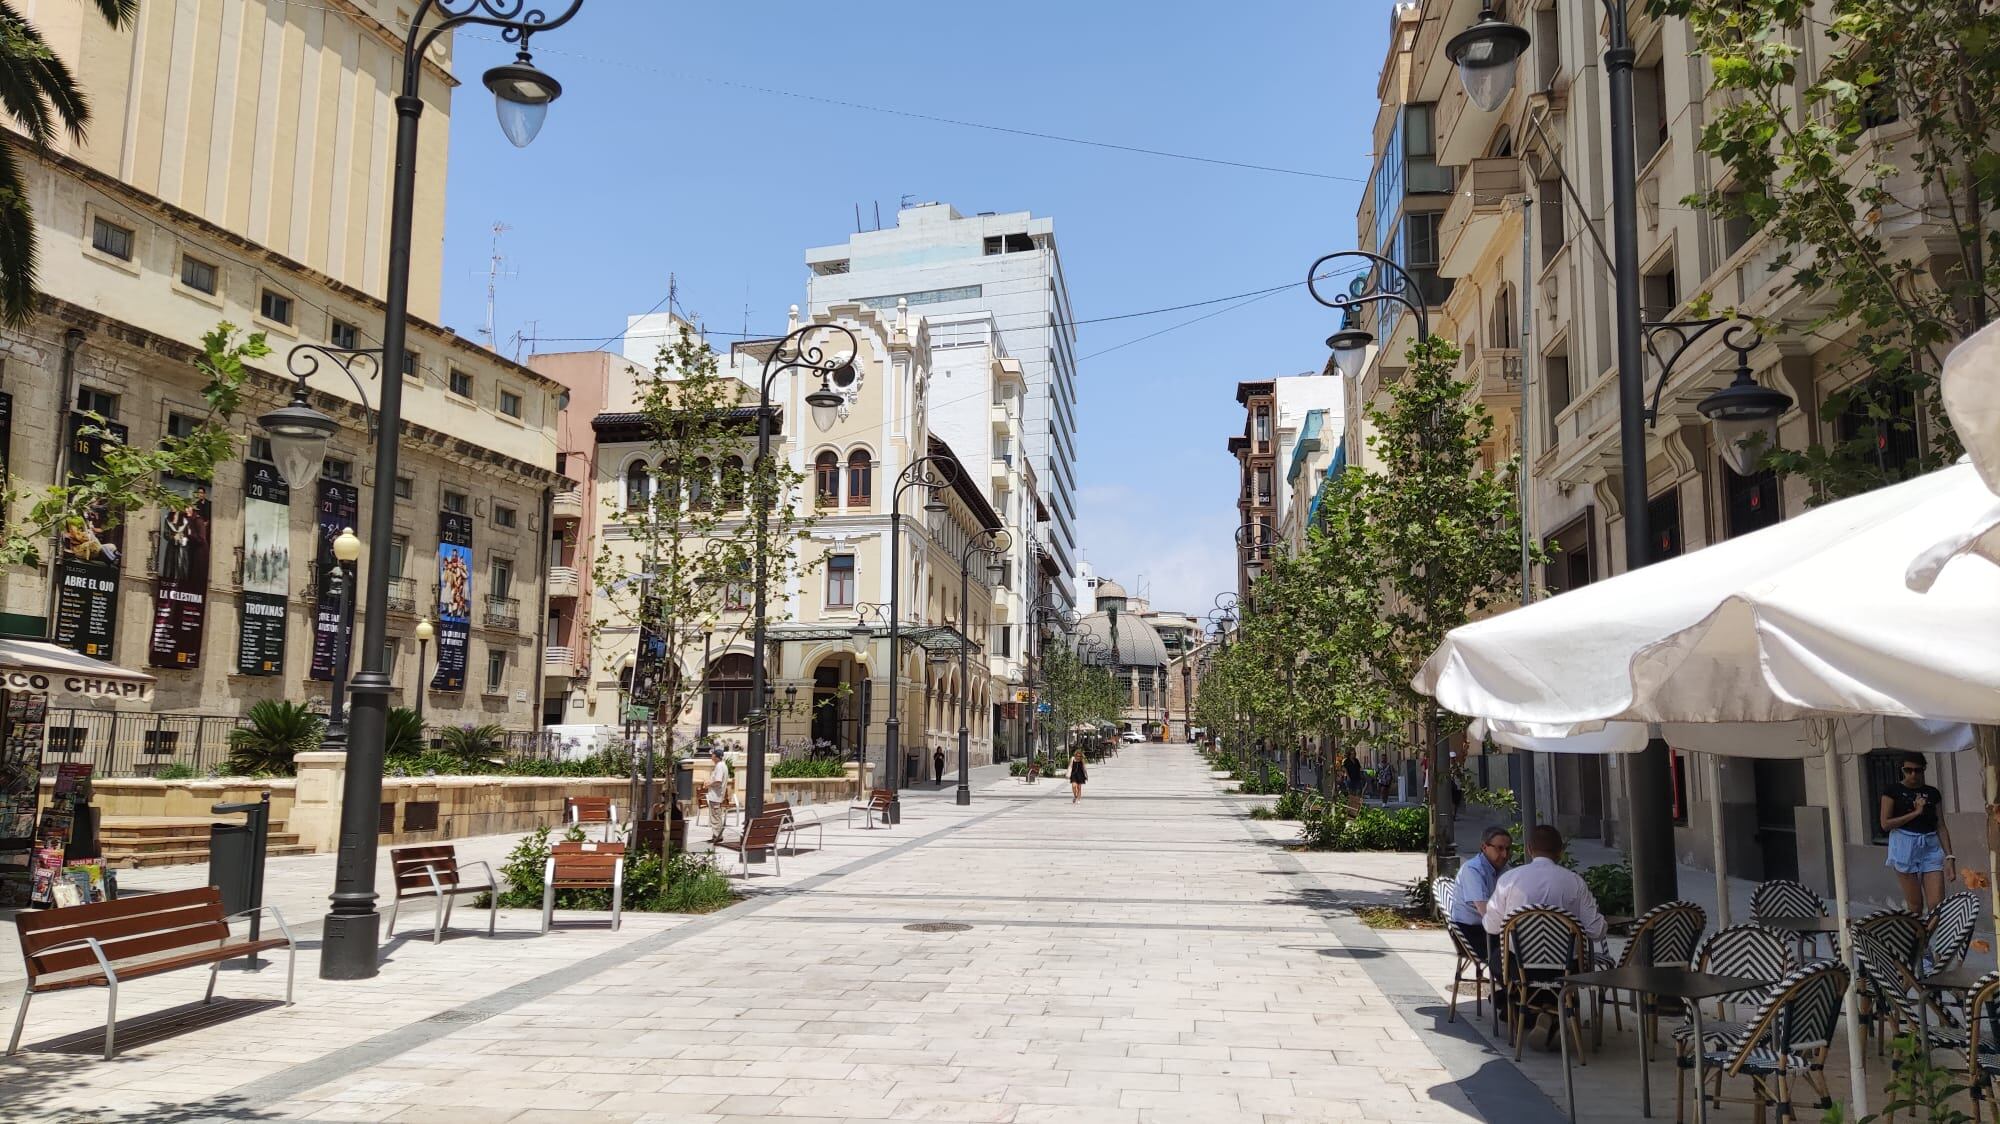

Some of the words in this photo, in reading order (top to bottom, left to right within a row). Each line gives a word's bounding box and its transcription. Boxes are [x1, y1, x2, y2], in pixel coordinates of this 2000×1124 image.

[79, 440, 89, 454] 16
[252, 484, 263, 497] 20
[324, 501, 333, 513] 21
[64, 575, 87, 589] ABRE
[88, 578, 98, 590] EL
[99, 580, 115, 592] OJO
[160, 589, 168, 600] LA
[245, 602, 285, 618] TROYANAS
